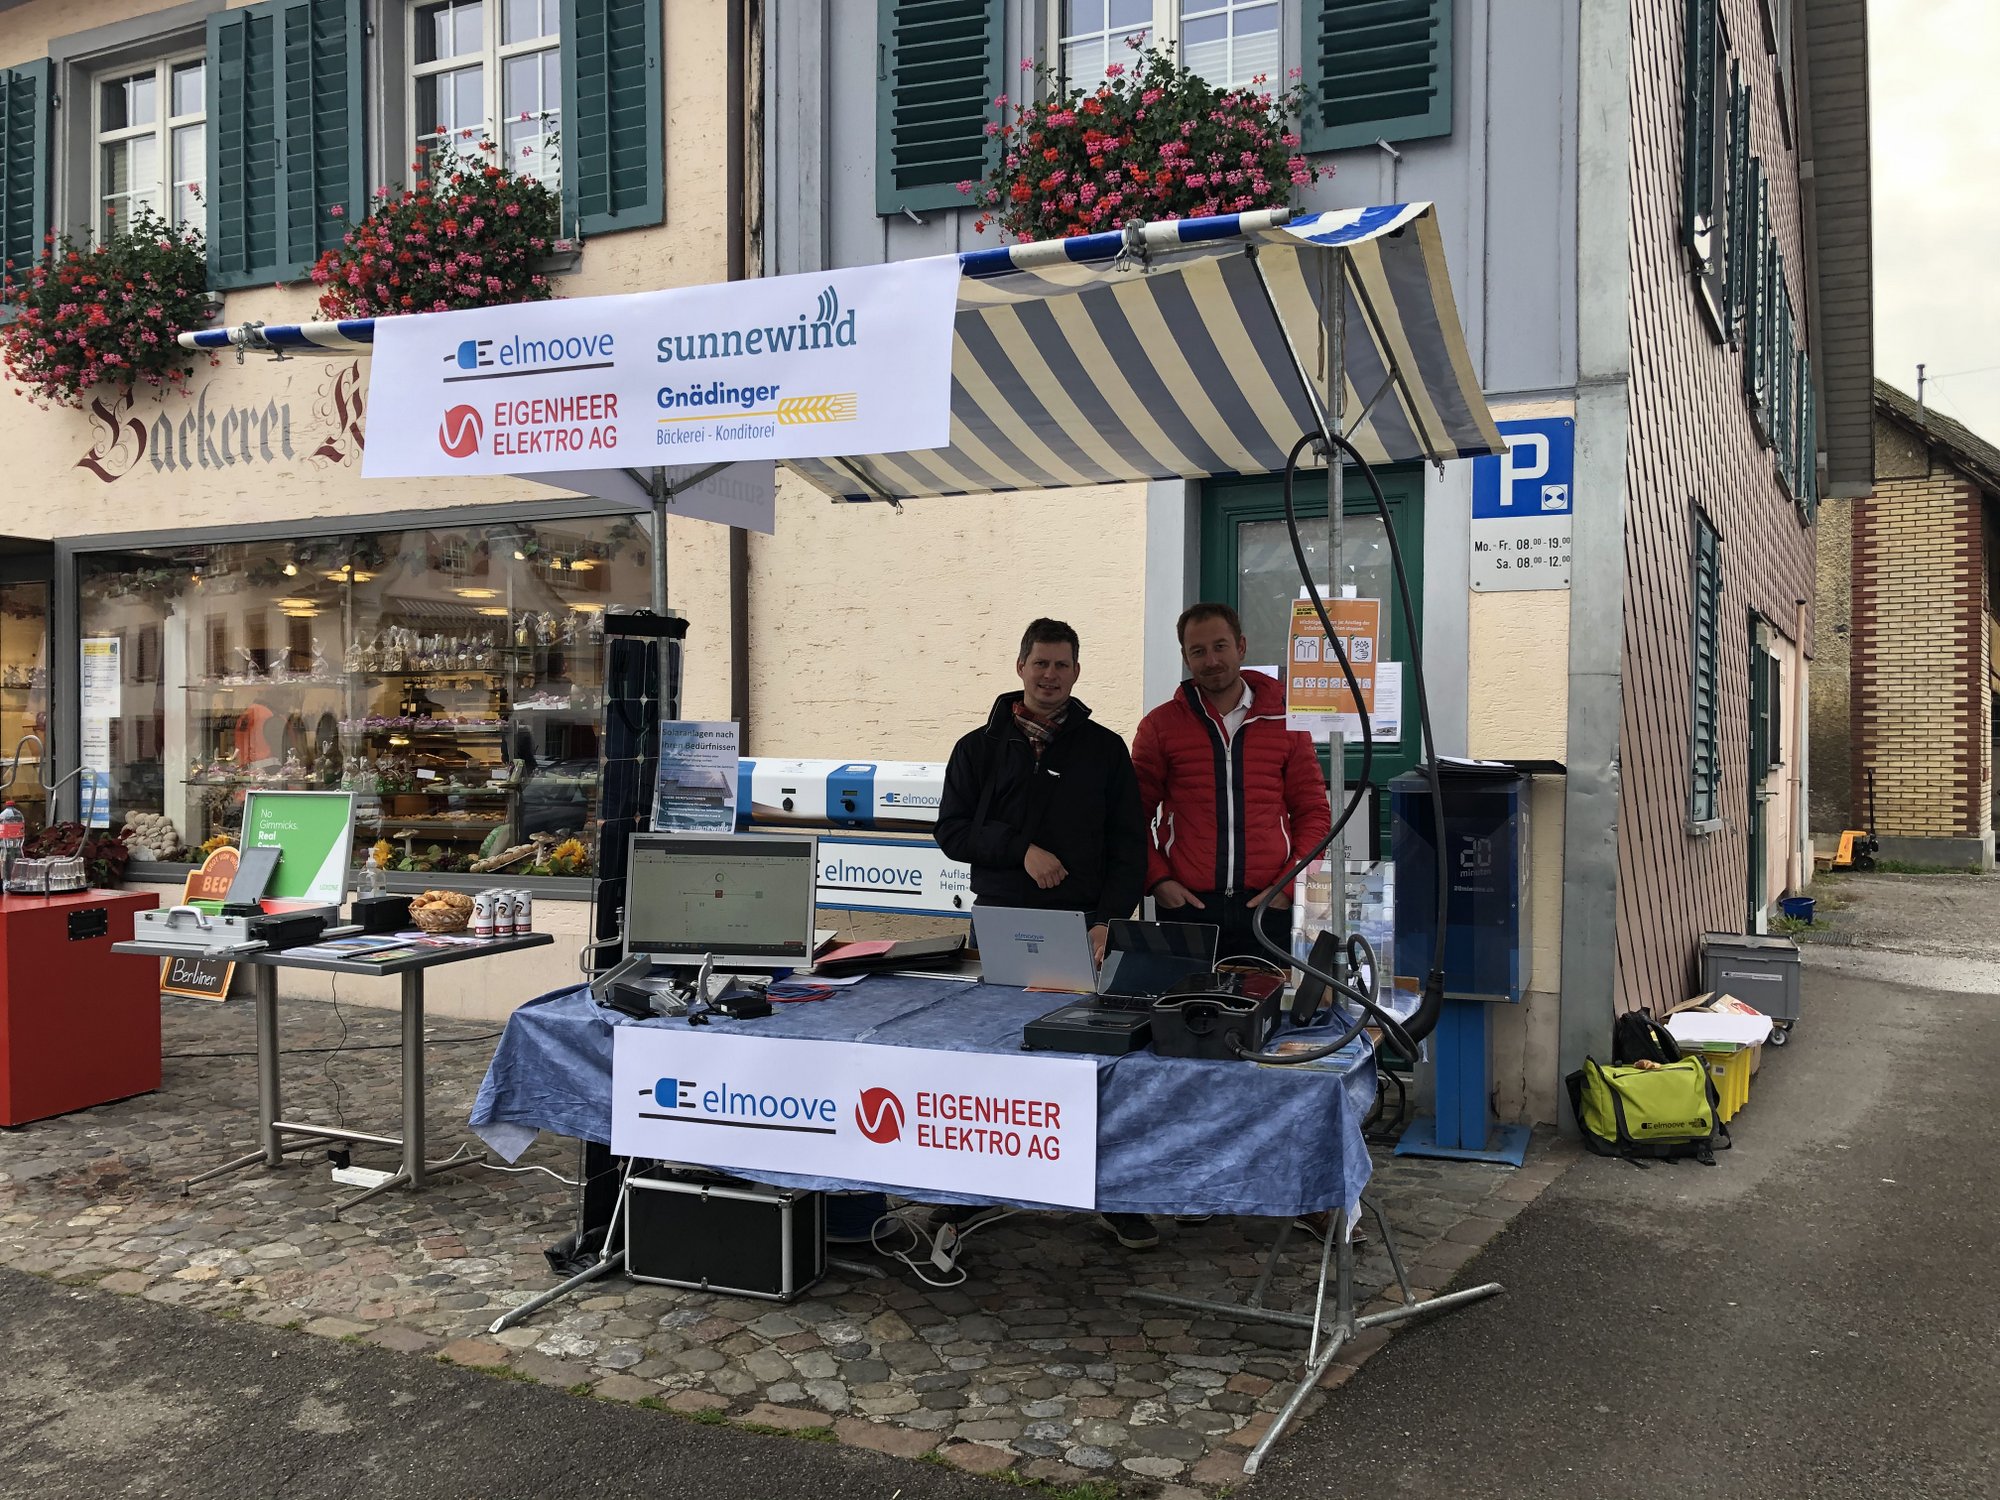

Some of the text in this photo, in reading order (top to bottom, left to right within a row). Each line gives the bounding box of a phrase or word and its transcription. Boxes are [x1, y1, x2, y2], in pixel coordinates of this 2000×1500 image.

[500, 334, 614, 366] elmoove
[657, 309, 857, 364] sunnewind
[657, 381, 781, 409] Gnädinger
[494, 393, 618, 427] EIGENHEER
[493, 425, 618, 455] ELEKTRO AG
[656, 426, 705, 446] Bäckerei
[715, 421, 776, 442] Konditorei
[1500, 432, 1550, 507] P
[1496, 558, 1512, 569] Sa.
[662, 728, 734, 738] Solaranlagen nach
[685, 742, 736, 751] Bedürfnissen
[261, 809, 273, 817] No
[902, 793, 941, 805] elmoov
[258, 831, 276, 840] Real
[259, 820, 299, 830] Gimmicks.
[1460, 836, 1492, 868] 20
[825, 859, 923, 886] elmoove
[940, 869, 972, 880] Auflac
[172, 957, 217, 986] Berliner
[703, 1082, 836, 1122] elmoove
[917, 1091, 1061, 1129] EIGENHEER
[917, 1124, 1060, 1161] ELEKTRO AG
